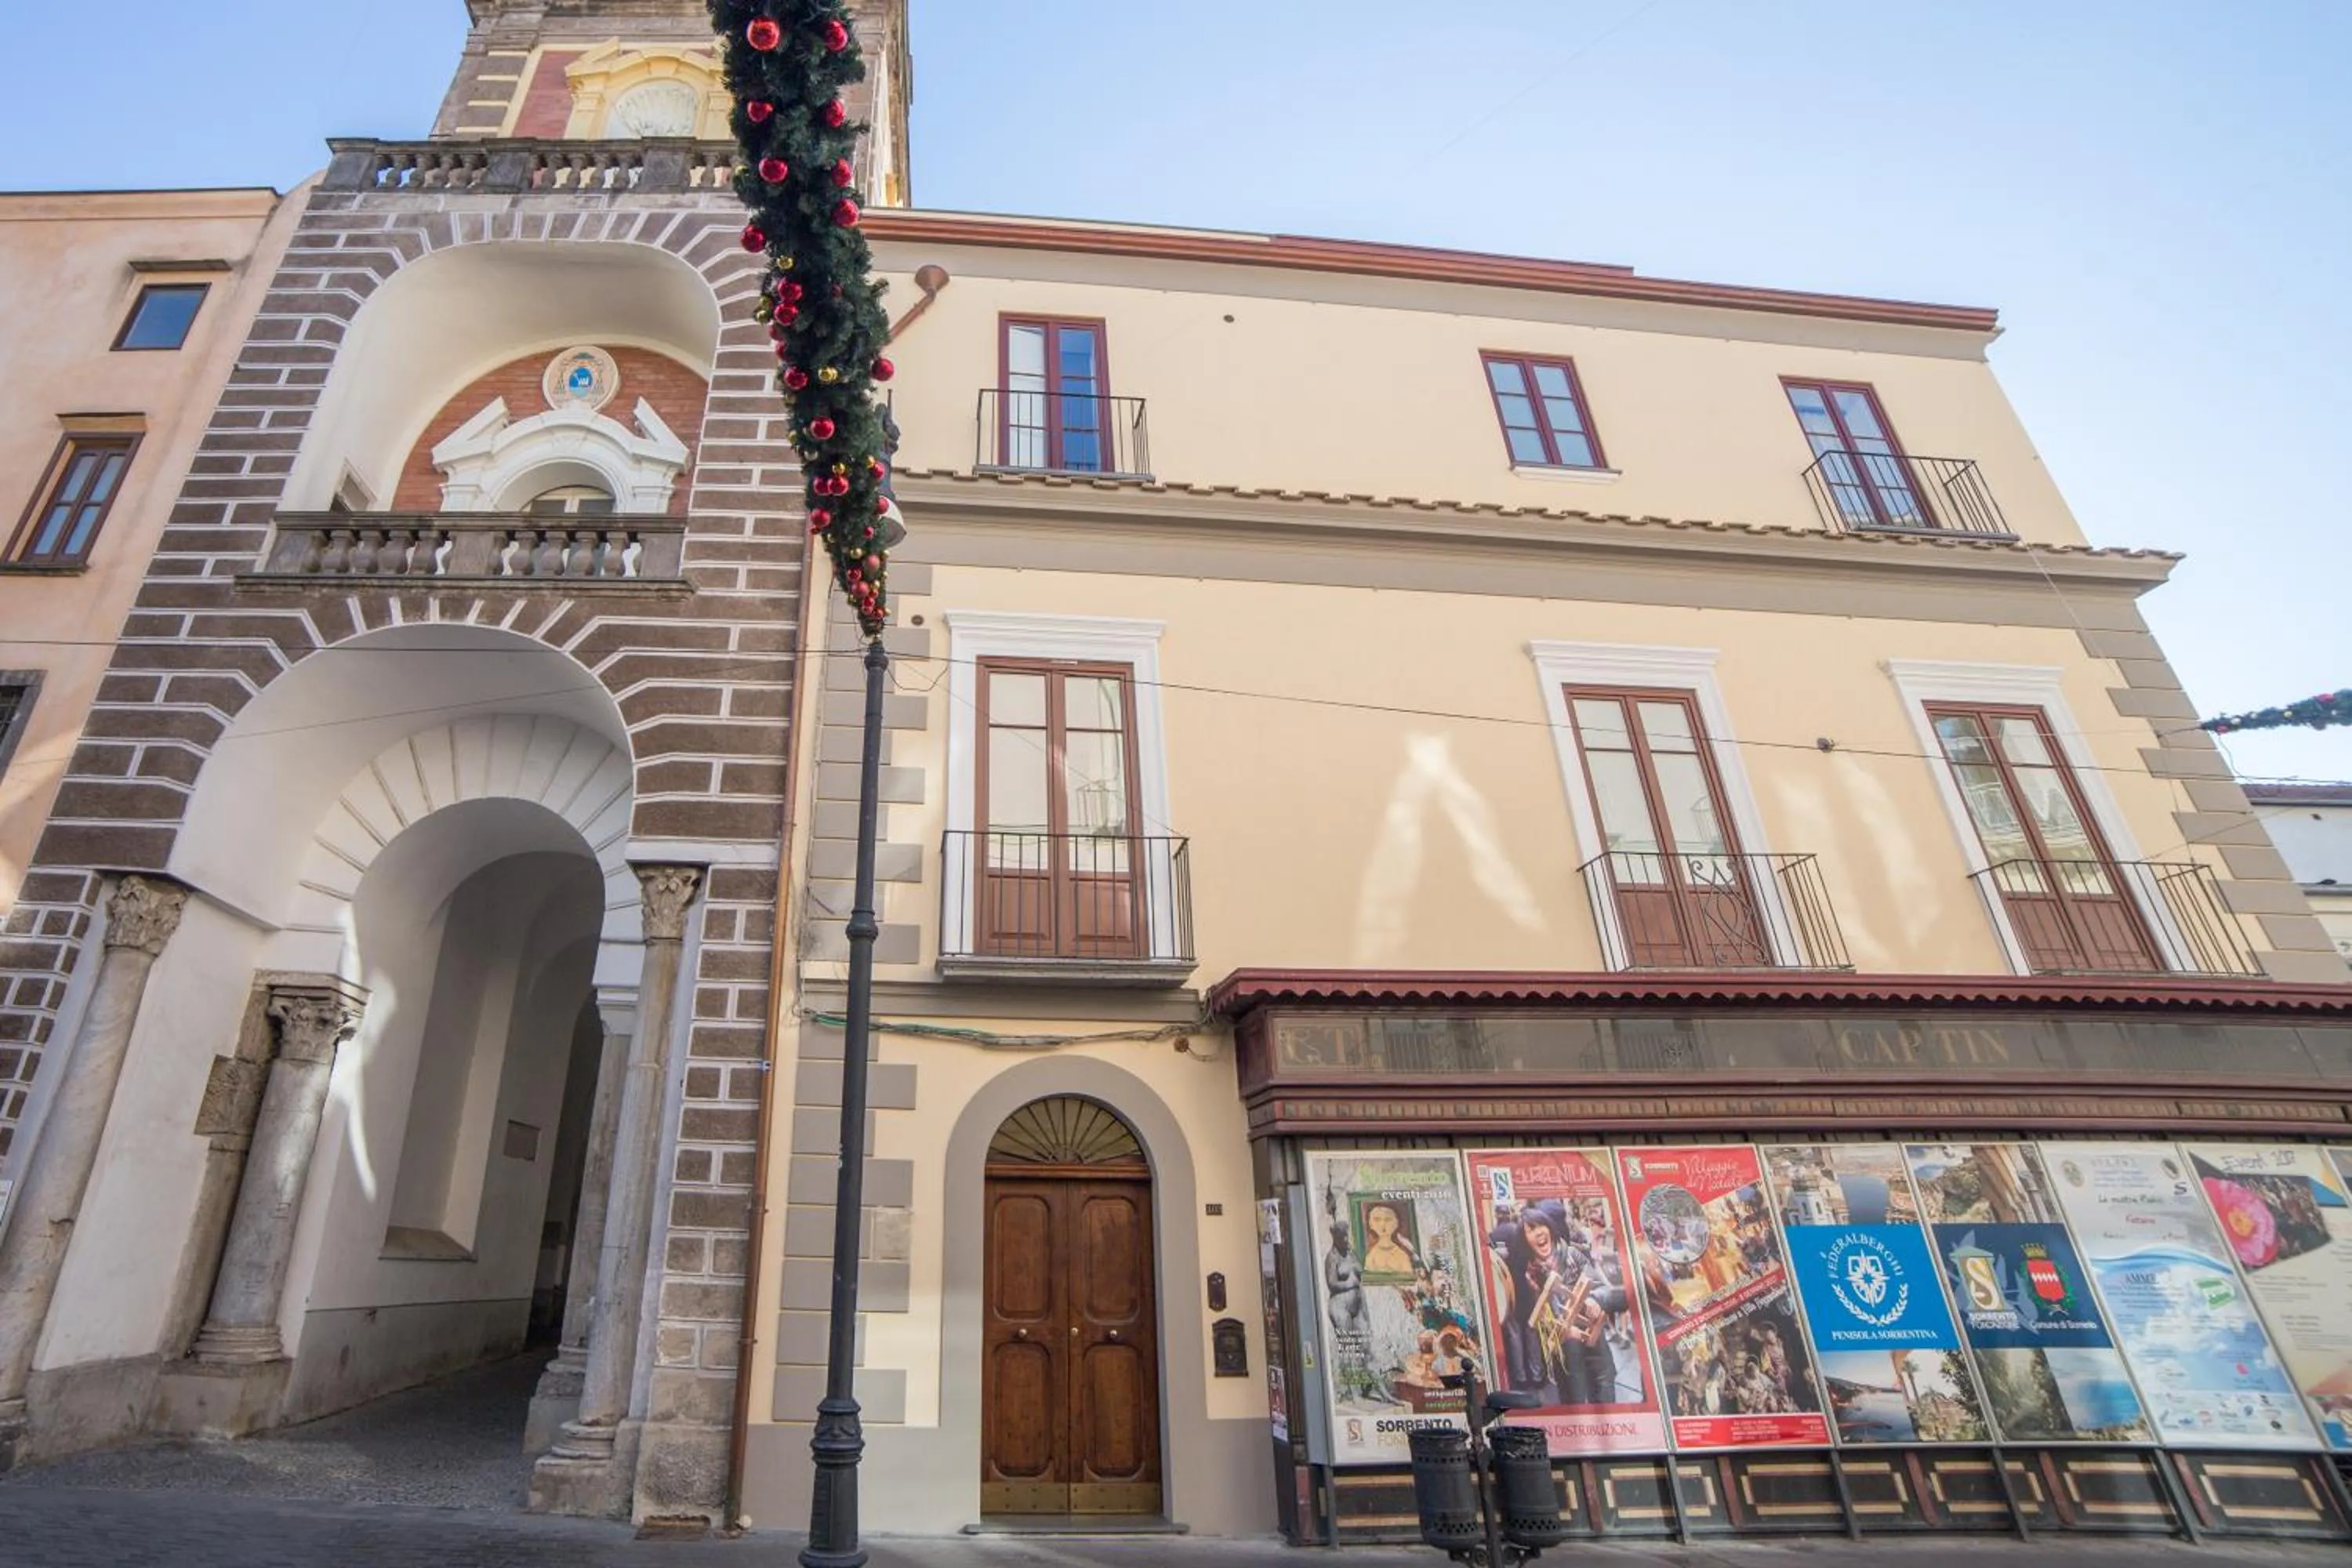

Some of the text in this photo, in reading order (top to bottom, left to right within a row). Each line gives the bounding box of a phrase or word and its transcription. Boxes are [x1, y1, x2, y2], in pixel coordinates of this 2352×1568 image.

[1381, 1188, 1420, 1200] eventi
[1828, 1232, 1904, 1279] FEDERALBERGHI
[1831, 1330, 1939, 1341] PENISOLA SORRENTINA
[1376, 1418, 1452, 1432] SORRENTO
